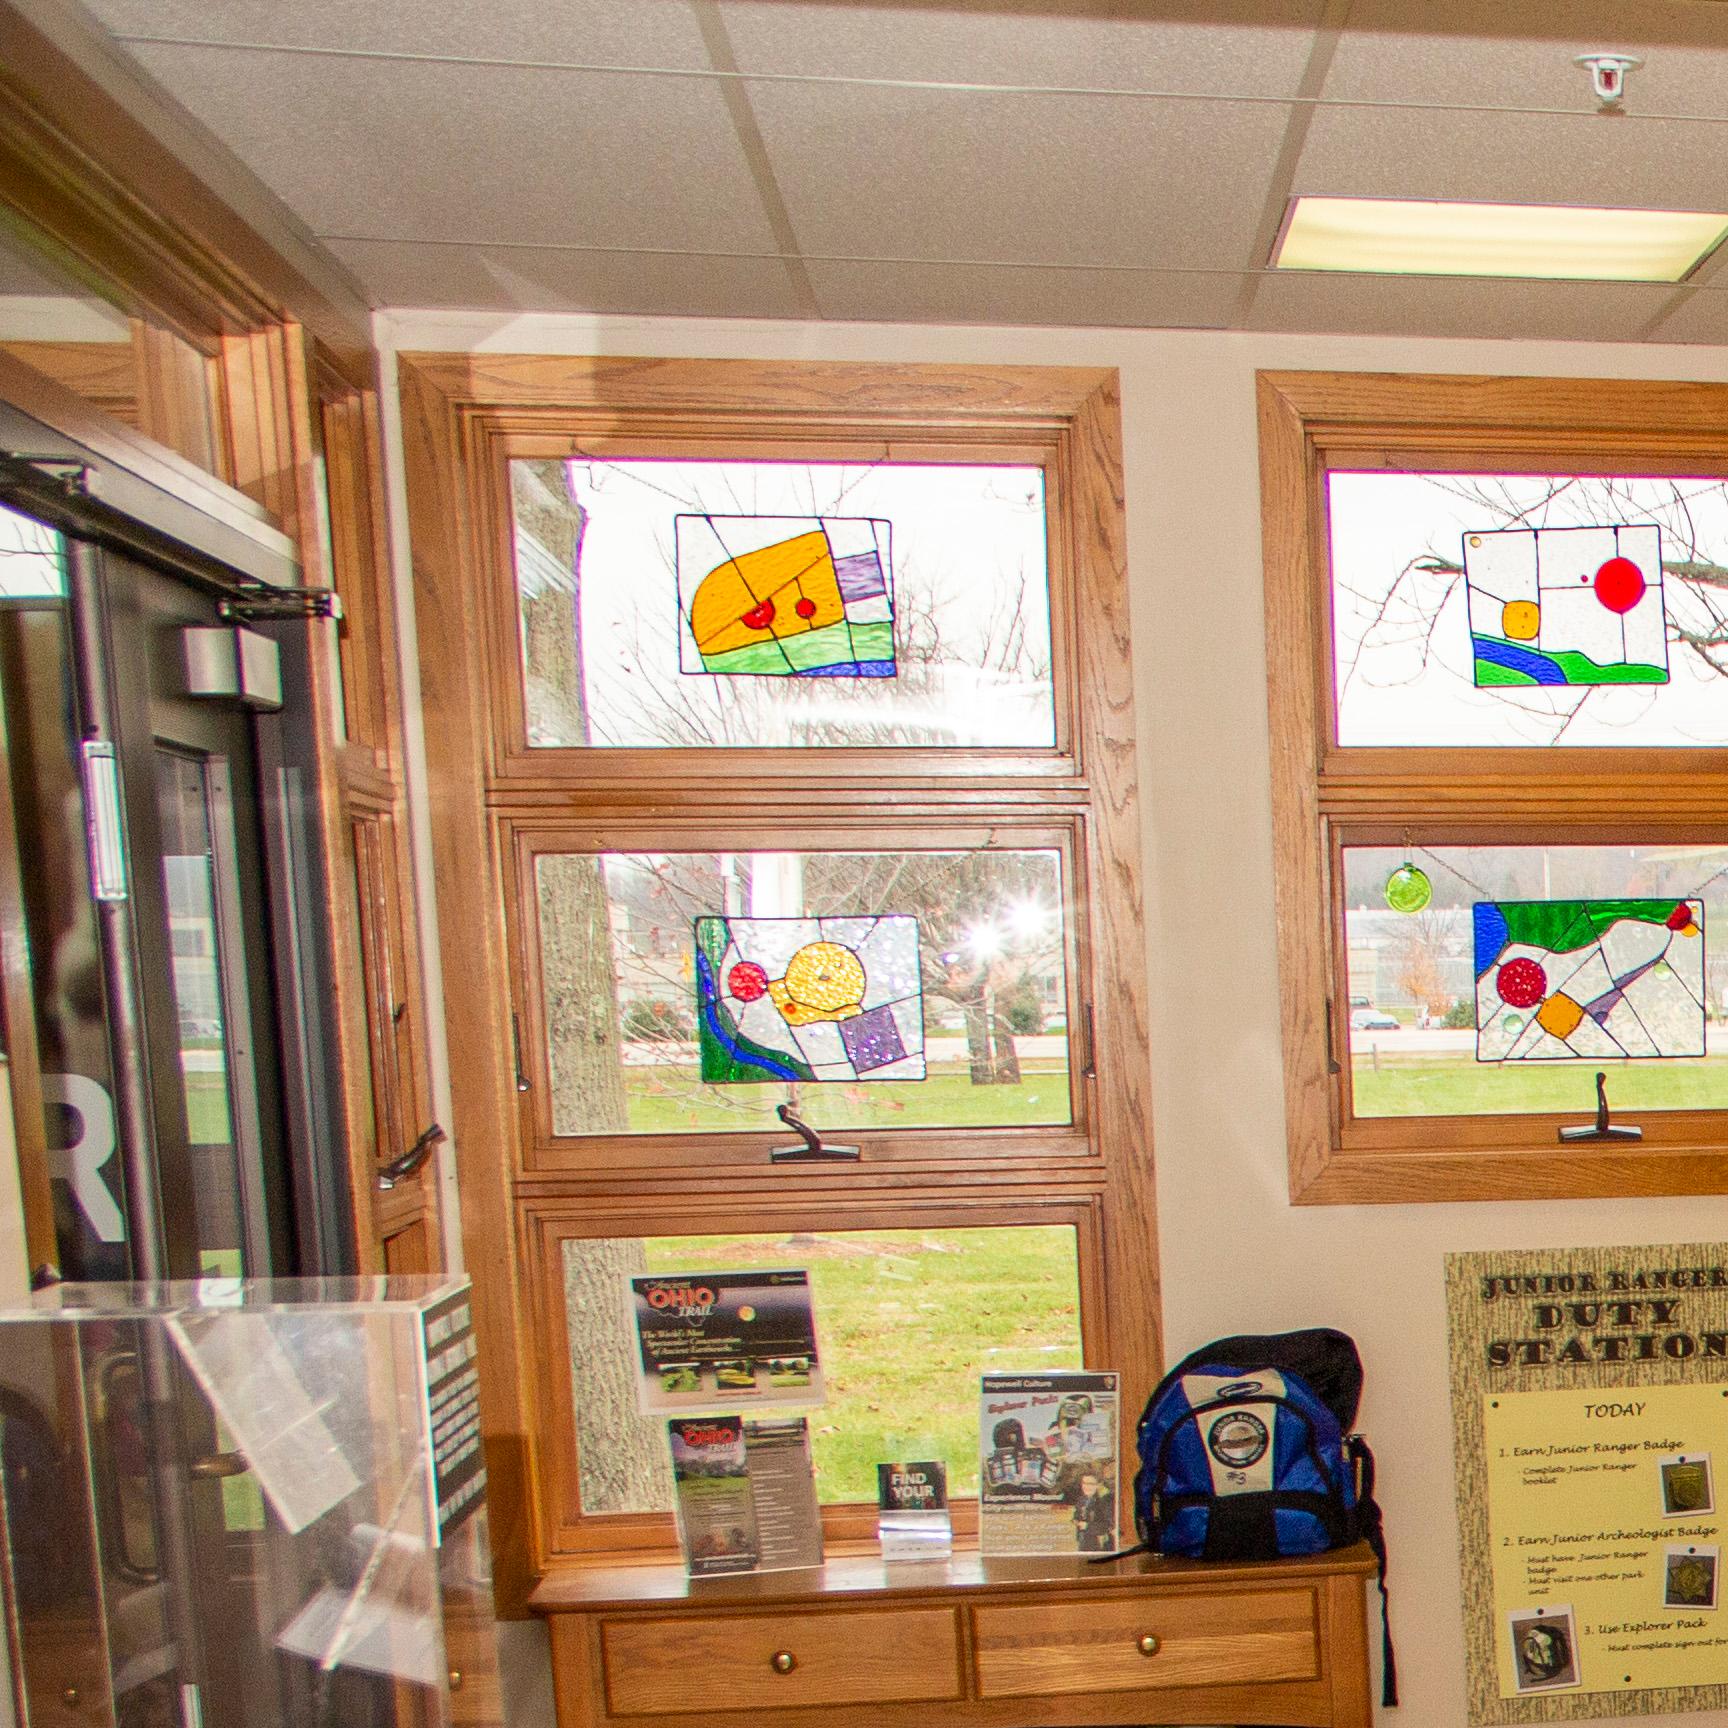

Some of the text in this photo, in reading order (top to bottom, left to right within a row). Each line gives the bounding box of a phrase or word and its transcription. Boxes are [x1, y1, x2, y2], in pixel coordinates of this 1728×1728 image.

[1482, 1271, 1598, 1300] JUNIOR
[647, 1286, 714, 1308] OHIO
[1532, 1300, 1681, 1330] DUTY
[1583, 1402, 1647, 1419] TODAY
[684, 1428, 735, 1446] OHIO
[1513, 1447, 1546, 1457] Earn
[1549, 1445, 1590, 1457] Junior
[1594, 1441, 1641, 1454] Ranger
[1643, 1439, 1684, 1451] Badge
[1602, 1463, 1638, 1472] Ranger
[892, 1473, 927, 1485] FIND
[1227, 1471, 1247, 1485] #3
[892, 1485, 935, 1497] YOUR
[1518, 1535, 1550, 1546] Earn
[1552, 1533, 1594, 1546] Junior
[1597, 1529, 1675, 1542] Archeologist
[1678, 1525, 1718, 1538] Badge
[1598, 1625, 1620, 1634] Use
[1623, 1621, 1674, 1634] Explorer
[1677, 1617, 1708, 1630] Pack
